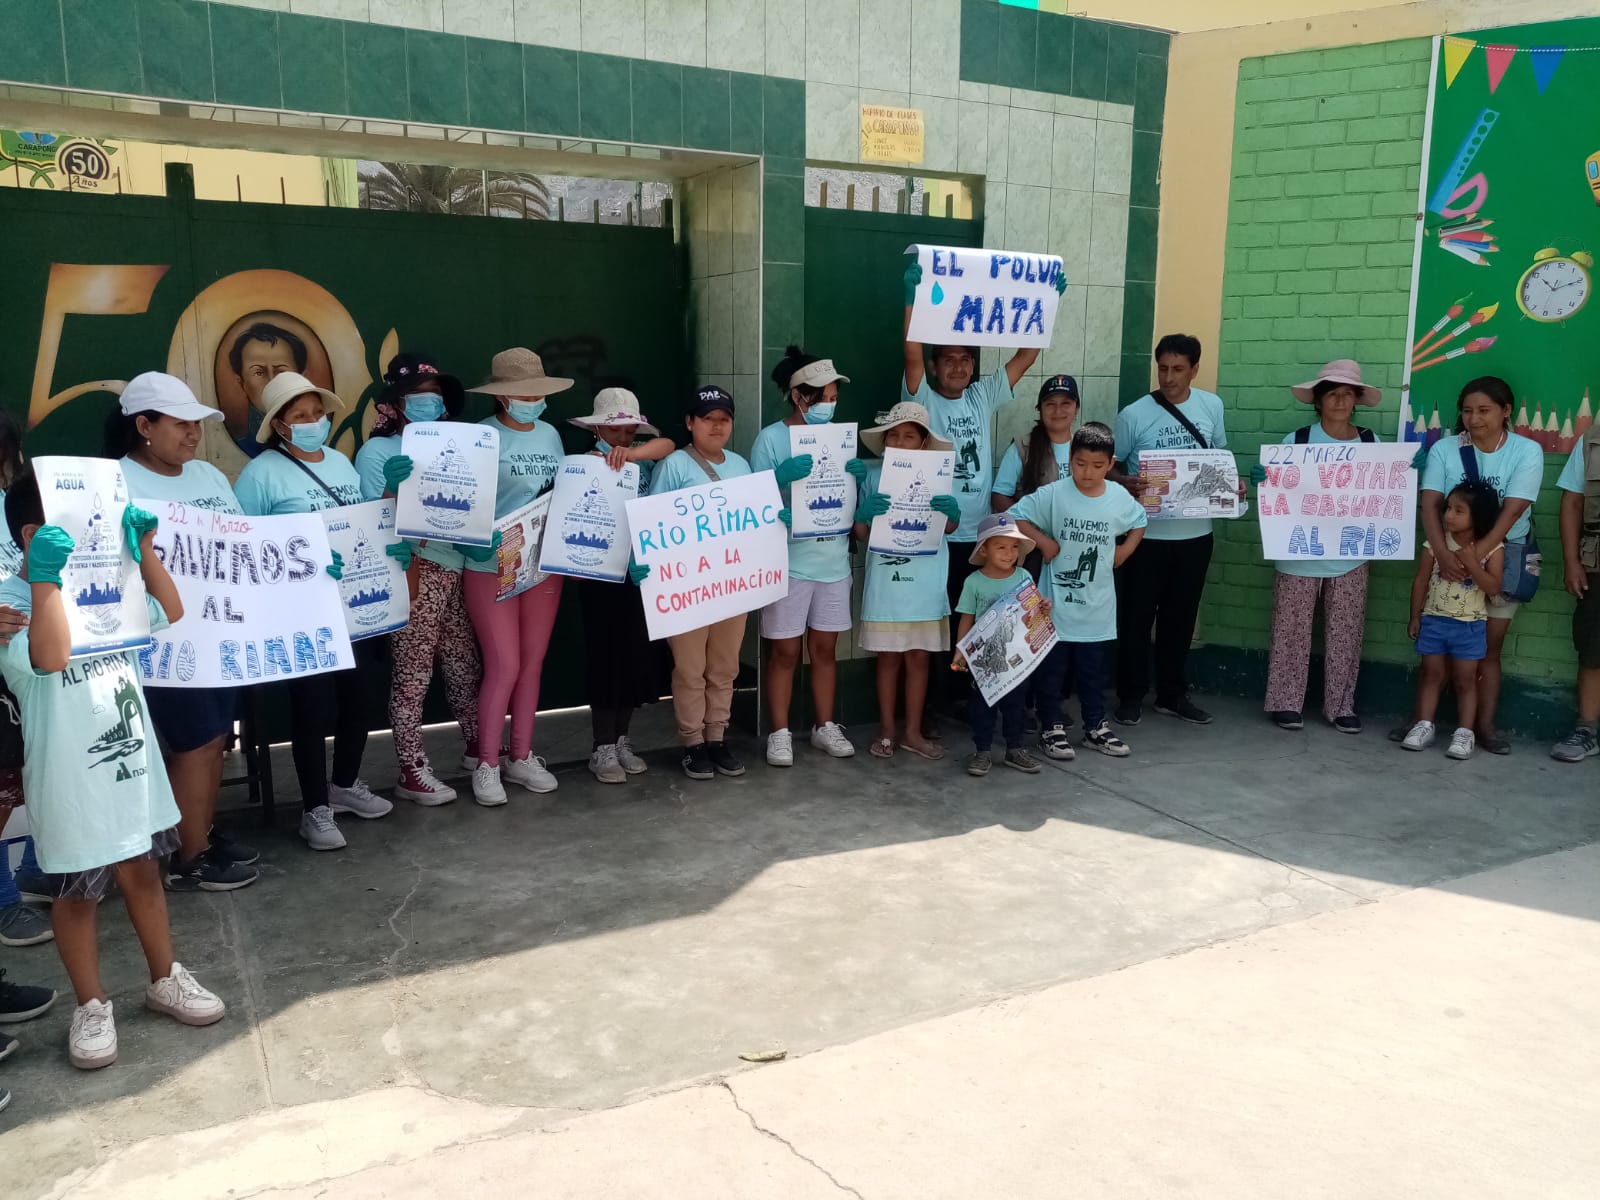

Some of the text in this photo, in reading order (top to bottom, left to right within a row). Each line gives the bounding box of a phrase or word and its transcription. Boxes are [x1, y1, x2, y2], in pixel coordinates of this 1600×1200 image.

[18, 143, 57, 153] CARAPONG
[71, 151, 99, 175] 50
[932, 249, 964, 277] EL
[952, 294, 1045, 335] MATA
[1268, 445, 1356, 465] 22 MARZO
[511, 465, 524, 476] AL
[565, 466, 586, 475] AGUA
[1260, 461, 1410, 490] NO VOTAR
[56, 478, 85, 491] AGUA
[674, 487, 728, 516] SOS
[1260, 493, 1291, 515] LA
[168, 502, 188, 525] 22
[211, 512, 254, 533] Marzo
[328, 522, 351, 532] AGUA
[1063, 517, 1109, 532] SALVEMOS
[1060, 530, 1068, 541] AL
[1288, 525, 1325, 556] AL
[660, 548, 741, 582] NO A LA
[201, 594, 244, 623] AL
[219, 626, 338, 681] RIMAC
[61, 667, 82, 688] AL
